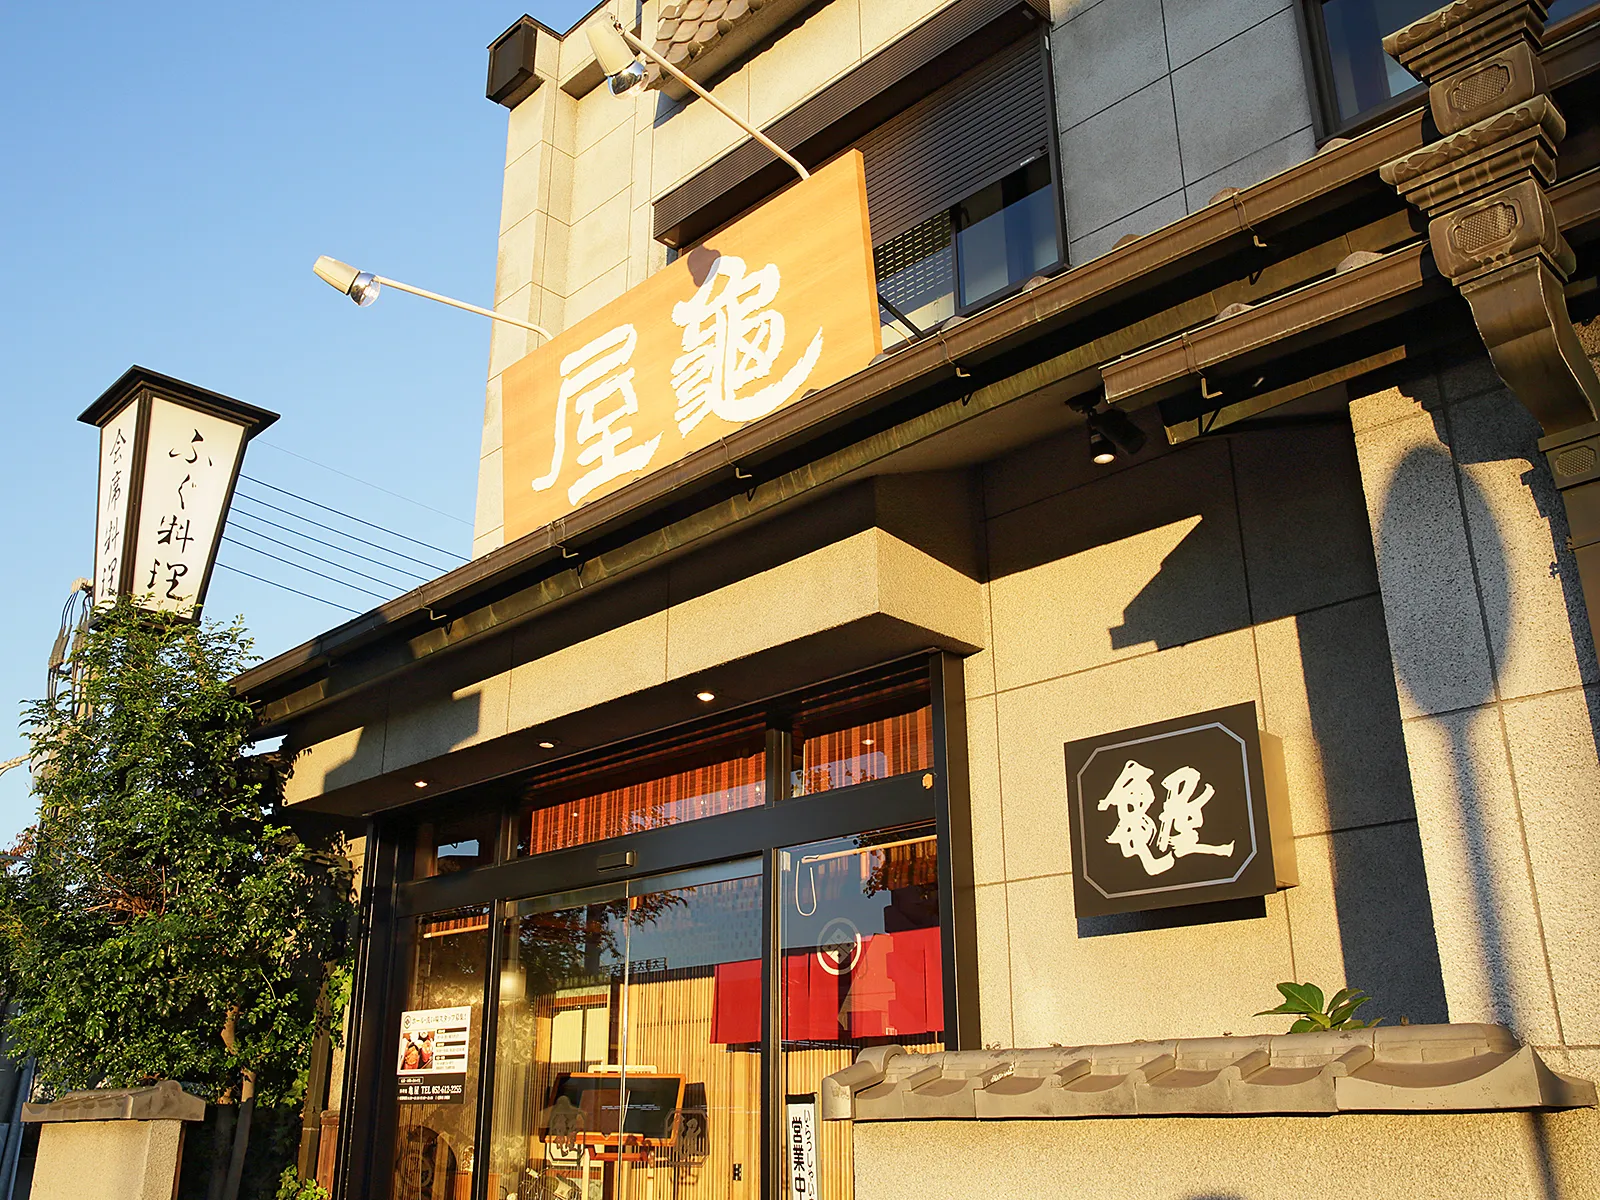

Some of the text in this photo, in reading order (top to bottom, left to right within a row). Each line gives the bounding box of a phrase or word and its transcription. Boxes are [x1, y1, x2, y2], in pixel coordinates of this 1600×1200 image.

[147, 429, 213, 600] ふぐ料理
[421, 1085, 431, 1094] TEL
[803, 1109, 815, 1200] いらっしゃい
